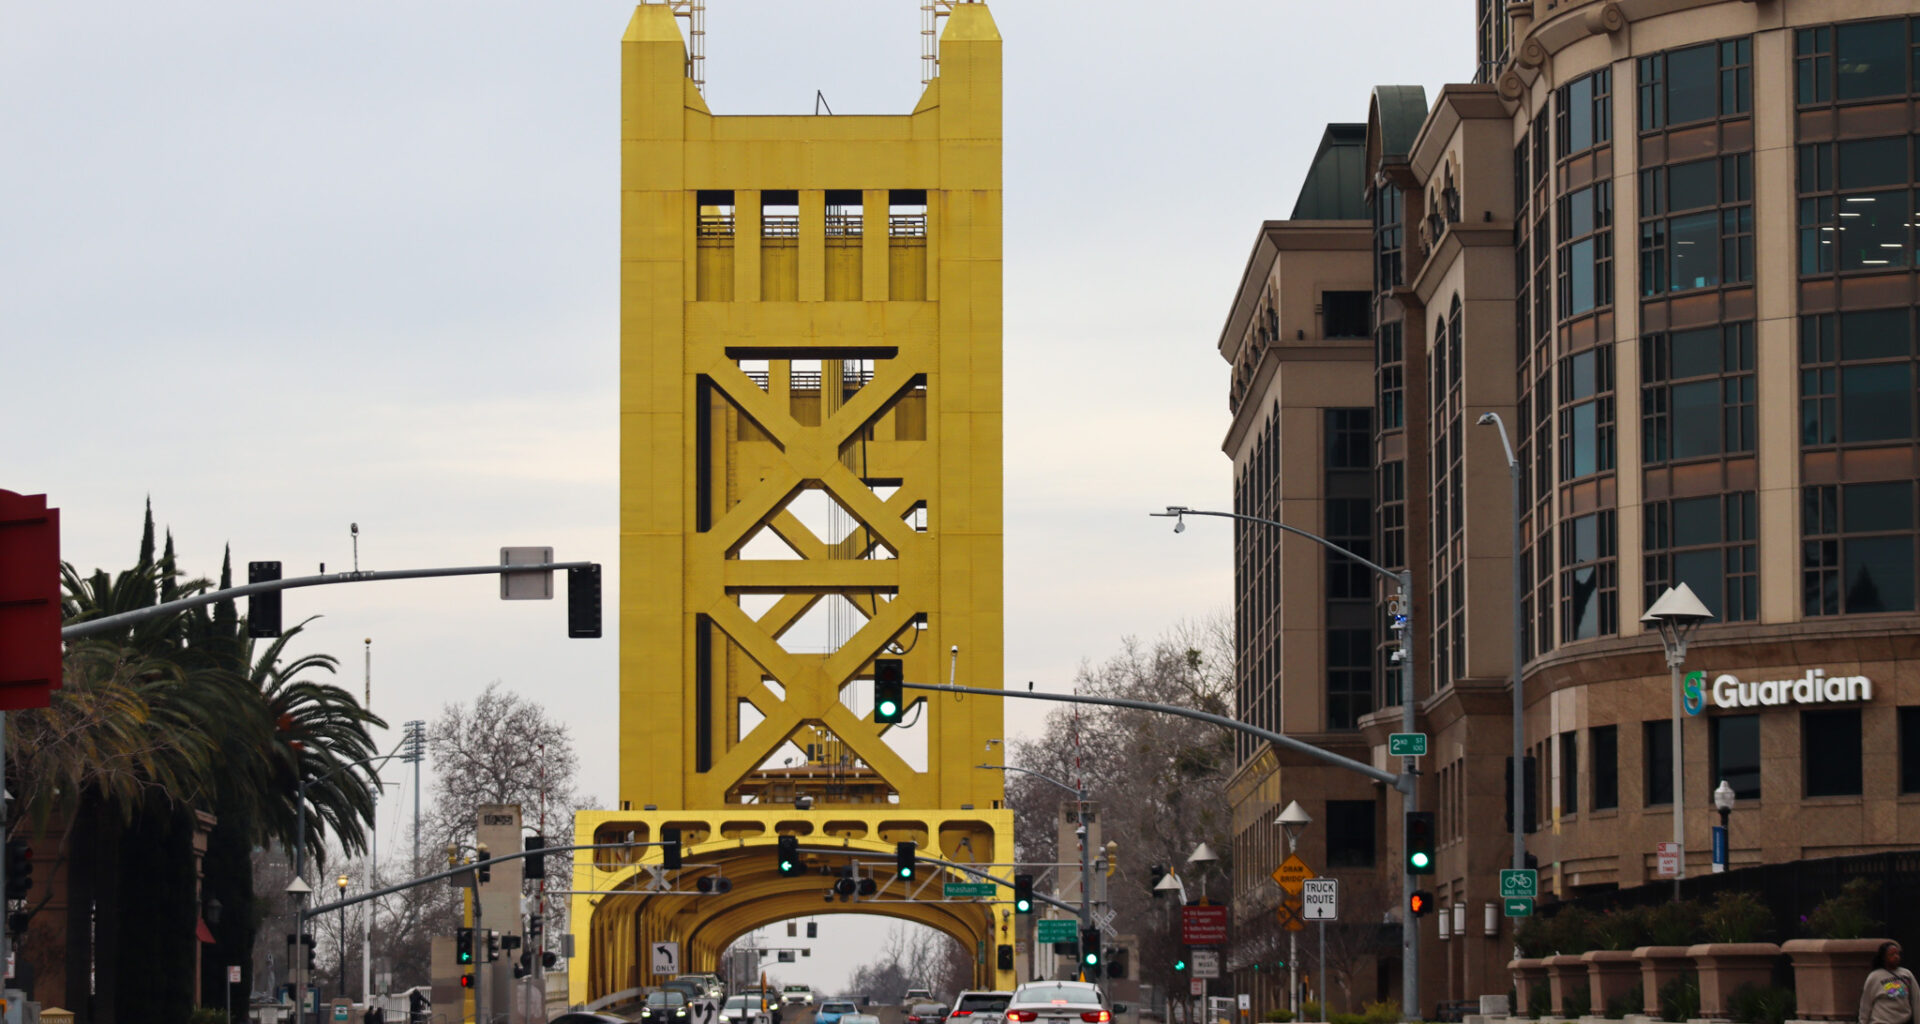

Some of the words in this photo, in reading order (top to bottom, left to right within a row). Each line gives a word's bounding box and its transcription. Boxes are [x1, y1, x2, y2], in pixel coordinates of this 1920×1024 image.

[1712, 668, 1872, 708] Guardian
[946, 886, 978, 894] Neasham
[1306, 883, 1334, 893] TRUCK
[1306, 894, 1334, 904] ROUTE
[656, 964, 676, 972] ONLY
